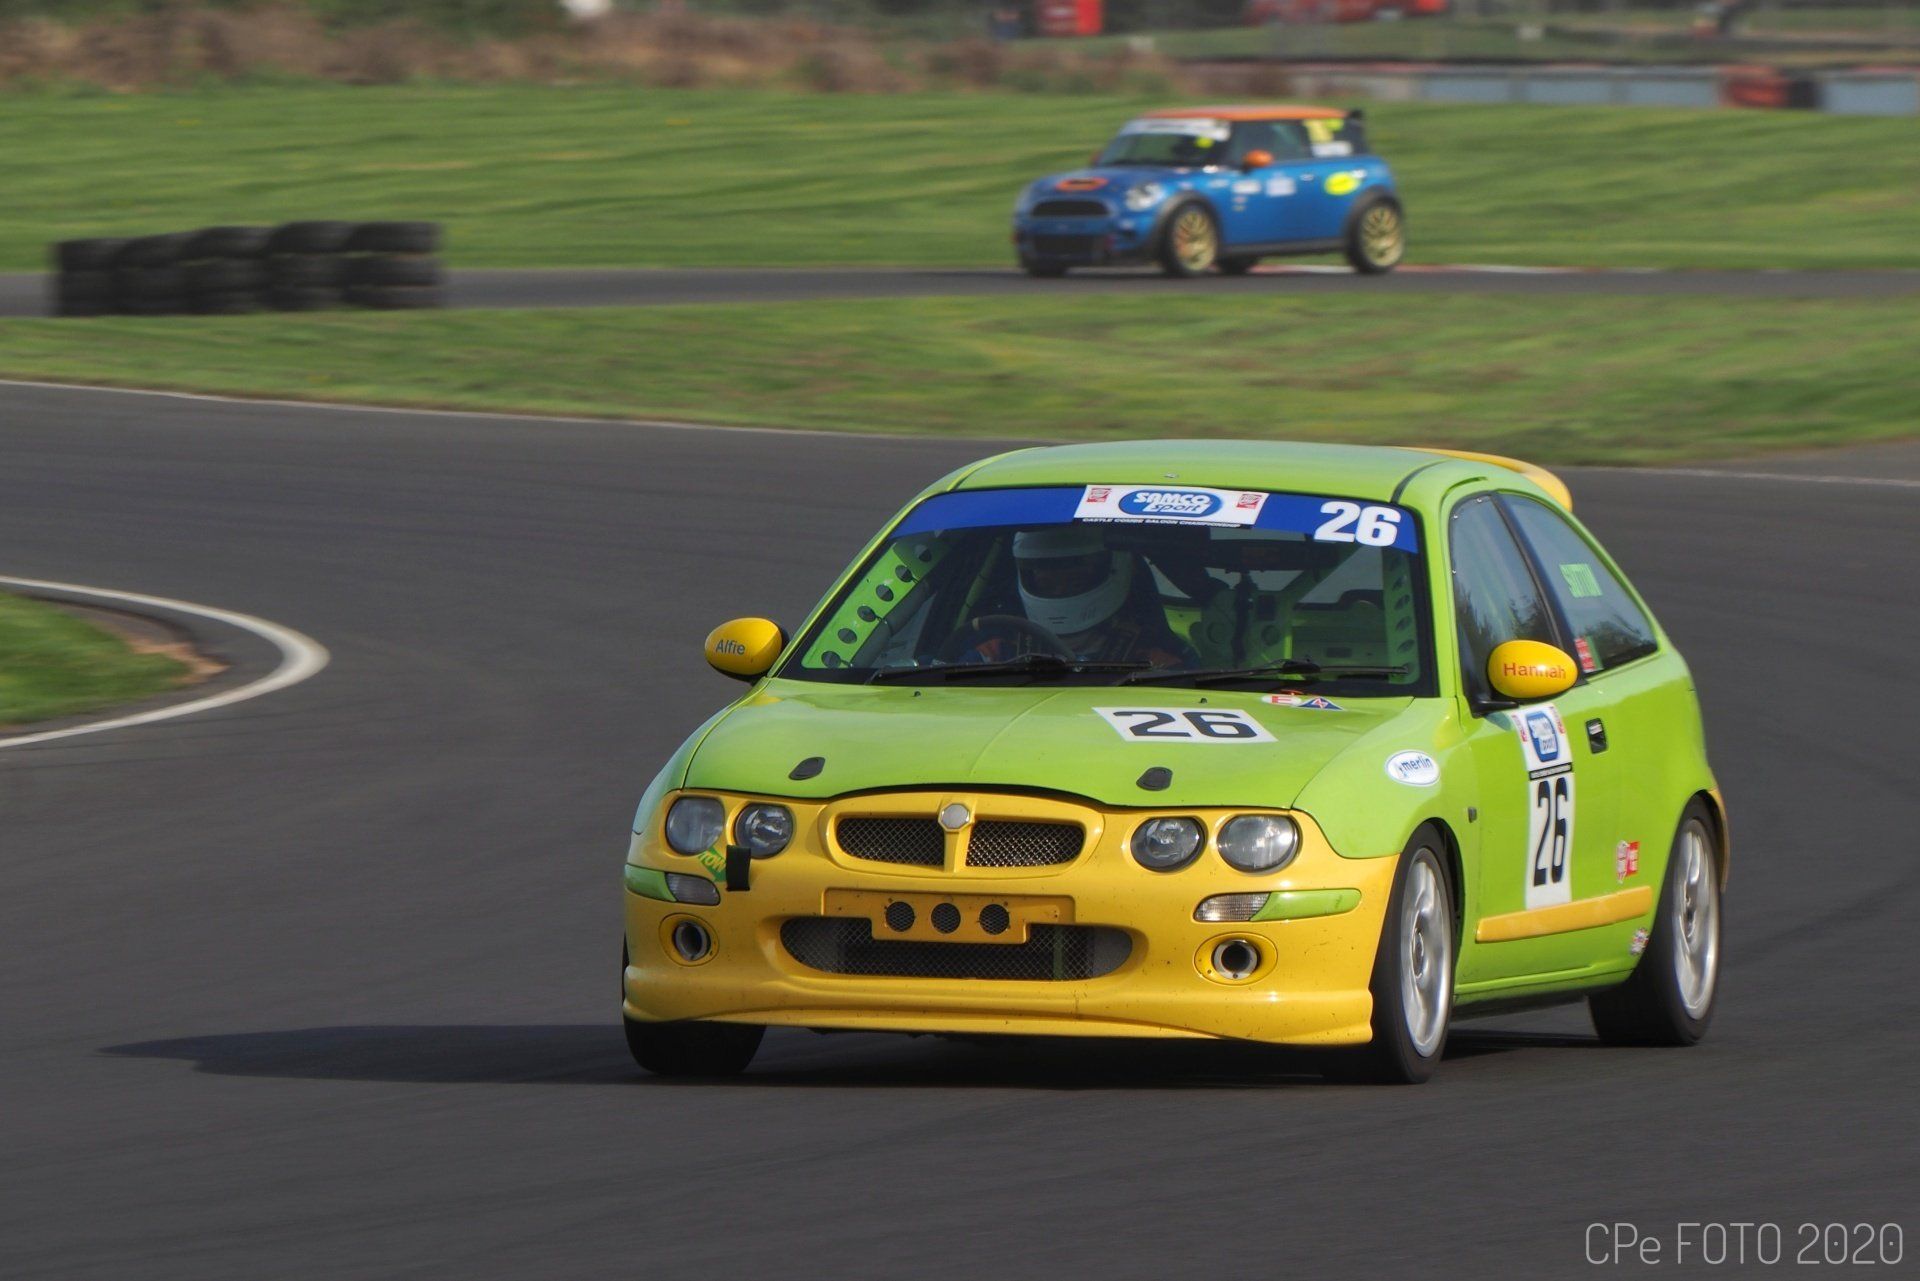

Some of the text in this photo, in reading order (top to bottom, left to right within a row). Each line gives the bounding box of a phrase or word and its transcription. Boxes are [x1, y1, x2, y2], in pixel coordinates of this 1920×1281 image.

[1133, 491, 1211, 505] SAMCO
[1313, 501, 1401, 547] 26
[715, 639, 746, 656] Alfie
[1503, 662, 1567, 680] Hannah
[1113, 711, 1257, 738] 26
[1533, 776, 1569, 887] 26
